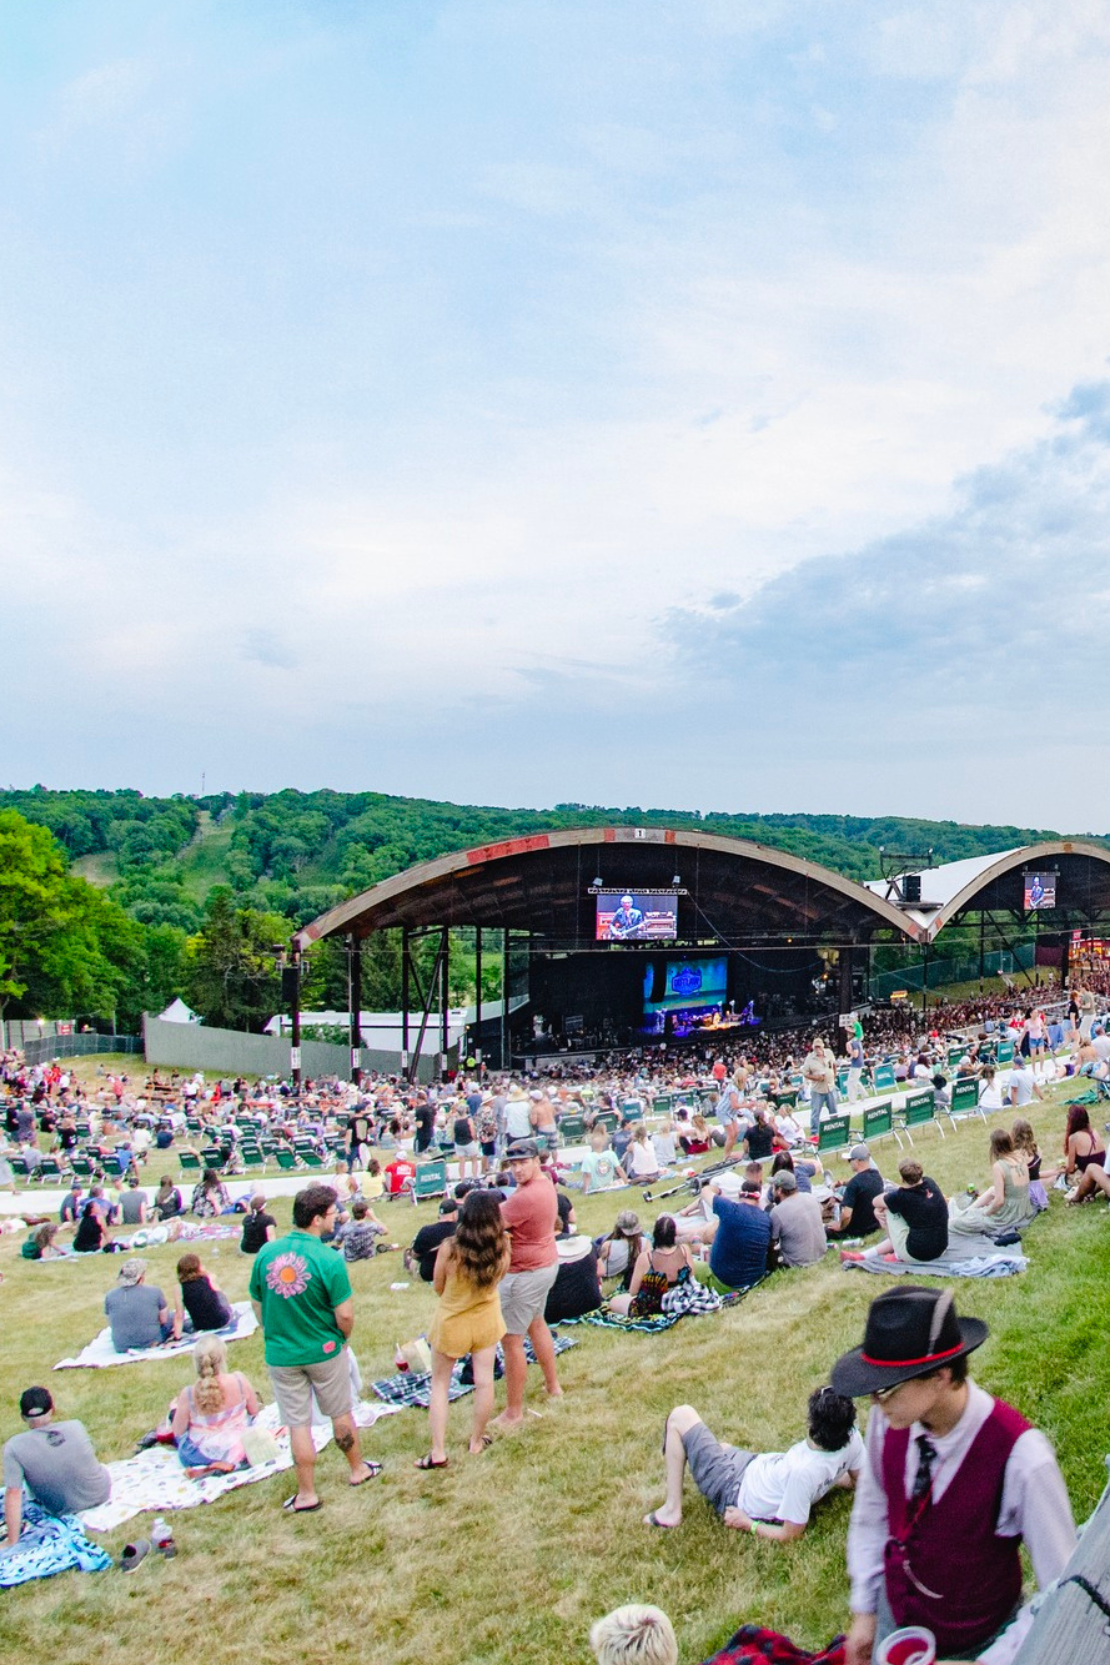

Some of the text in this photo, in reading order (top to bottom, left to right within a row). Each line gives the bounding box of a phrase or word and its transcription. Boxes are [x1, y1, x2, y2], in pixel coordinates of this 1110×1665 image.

[956, 1084, 976, 1094] RENTAL
[909, 1096, 931, 1107] RENTAL
[867, 1108, 888, 1120] RENTAL
[823, 1121, 845, 1131] RENTAL
[420, 1172, 442, 1182] RENTAL
